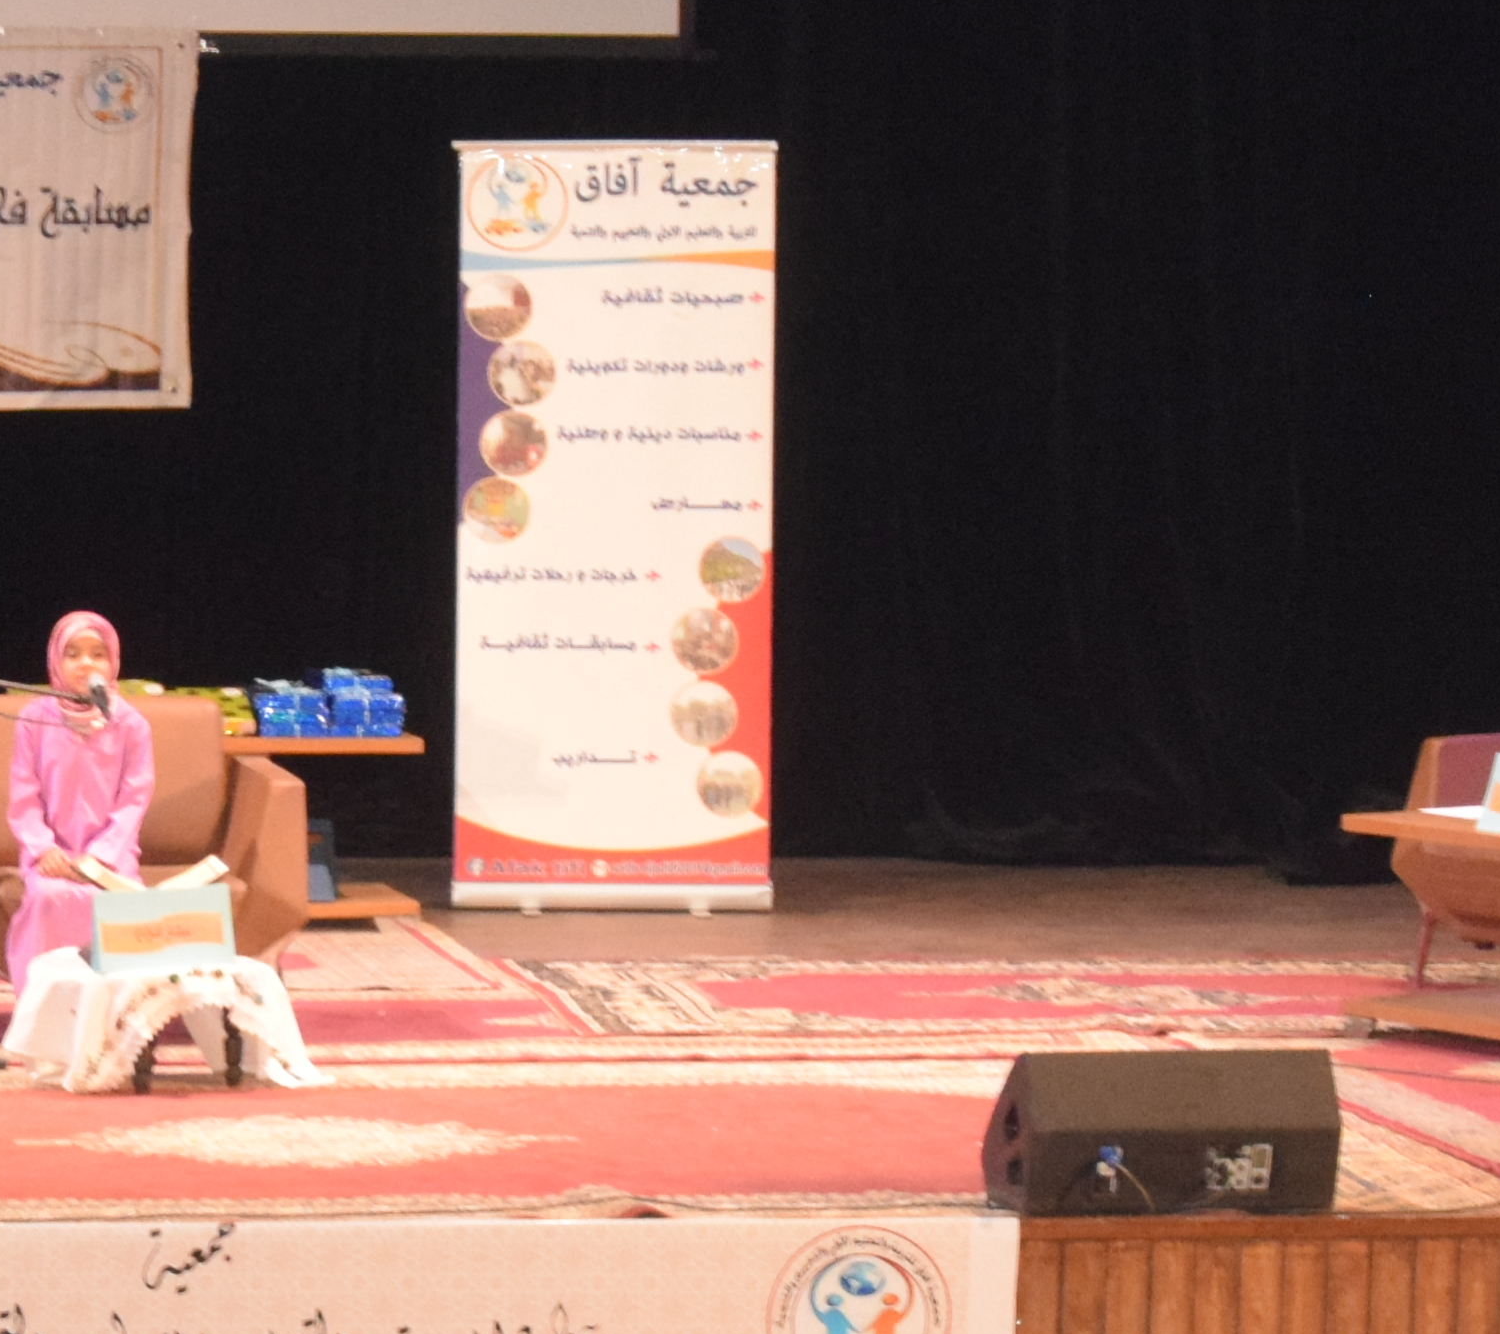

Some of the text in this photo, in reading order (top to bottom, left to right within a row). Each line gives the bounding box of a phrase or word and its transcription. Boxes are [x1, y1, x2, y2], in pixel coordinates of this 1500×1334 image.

[575, 156, 759, 208] جمعية آفاق
[40, 183, 152, 239] مسابقة
[142, 1222, 237, 1294] جمعية
